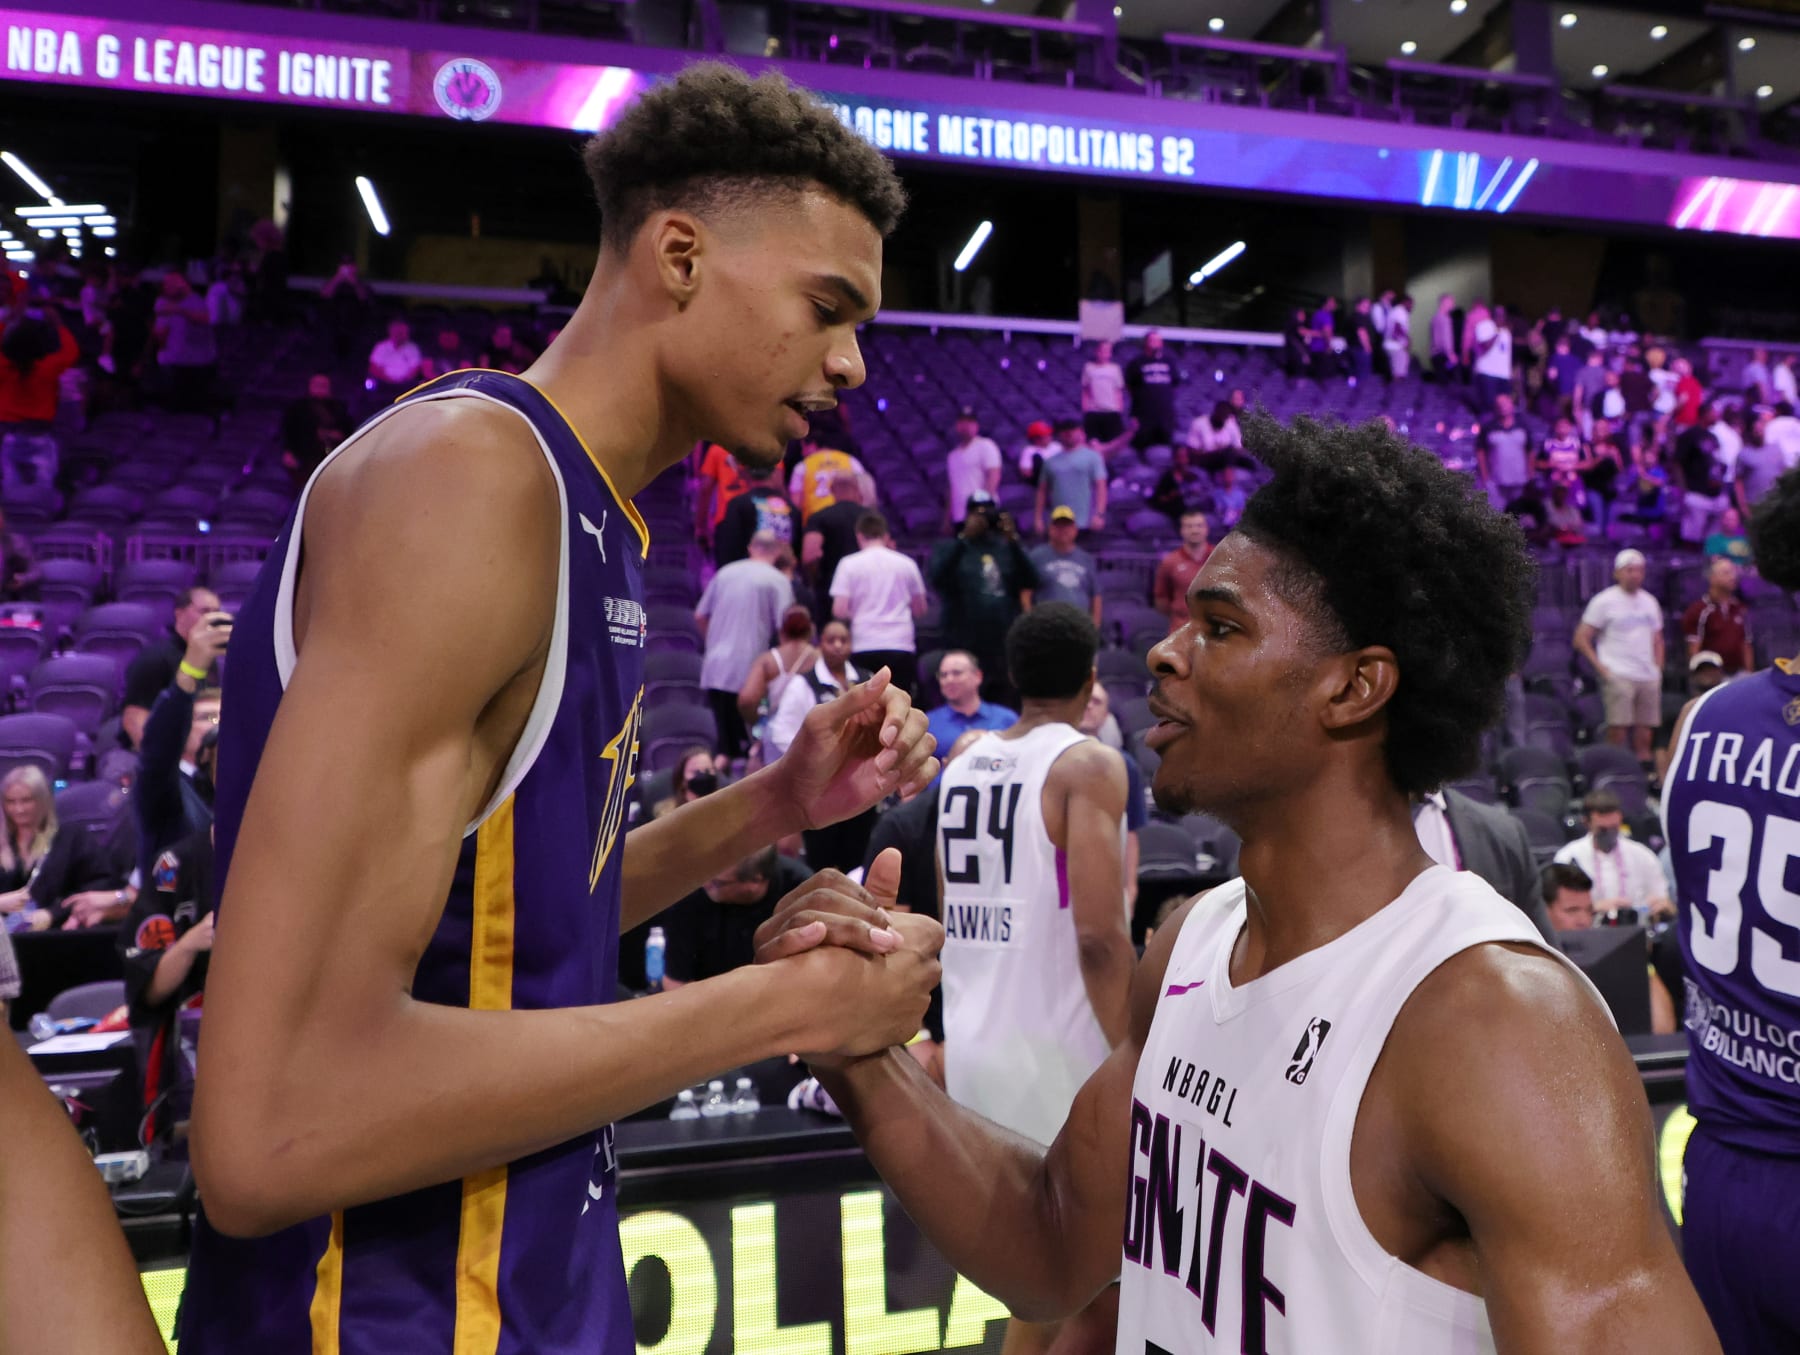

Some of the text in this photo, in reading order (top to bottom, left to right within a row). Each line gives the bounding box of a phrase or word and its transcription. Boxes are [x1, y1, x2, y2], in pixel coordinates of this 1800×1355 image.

[7, 25, 392, 104] NBA G LEAGUE IGNITE
[938, 114, 1155, 172] METROPOLITANS
[1161, 135, 1195, 176] 92
[943, 783, 1023, 884] 24
[1688, 800, 1800, 998] 35
[1162, 1055, 1238, 1129] NBAGL
